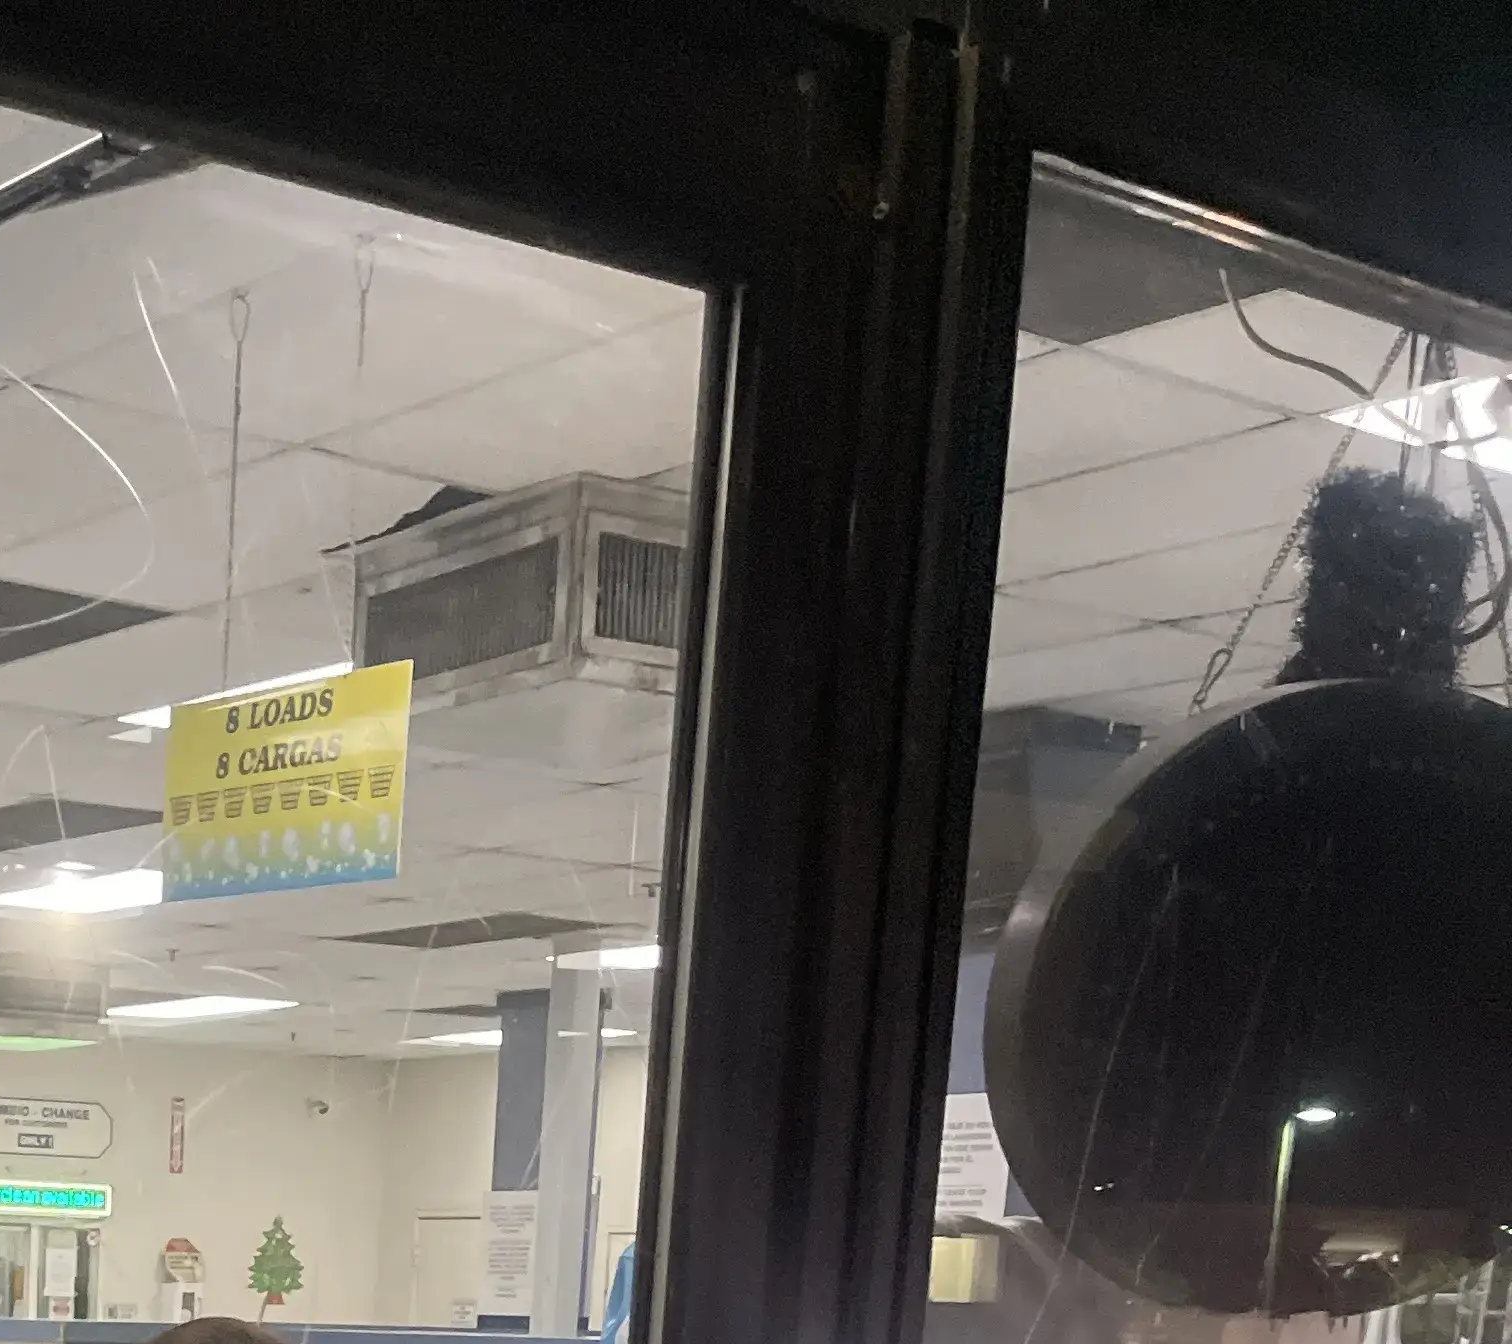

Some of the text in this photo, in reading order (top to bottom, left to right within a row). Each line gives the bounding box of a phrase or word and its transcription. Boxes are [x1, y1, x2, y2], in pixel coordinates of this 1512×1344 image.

[225, 688, 335, 734] 8 LOADS
[216, 734, 341, 779] 8 CARGAS
[41, 1107, 90, 1121] CHANGE
